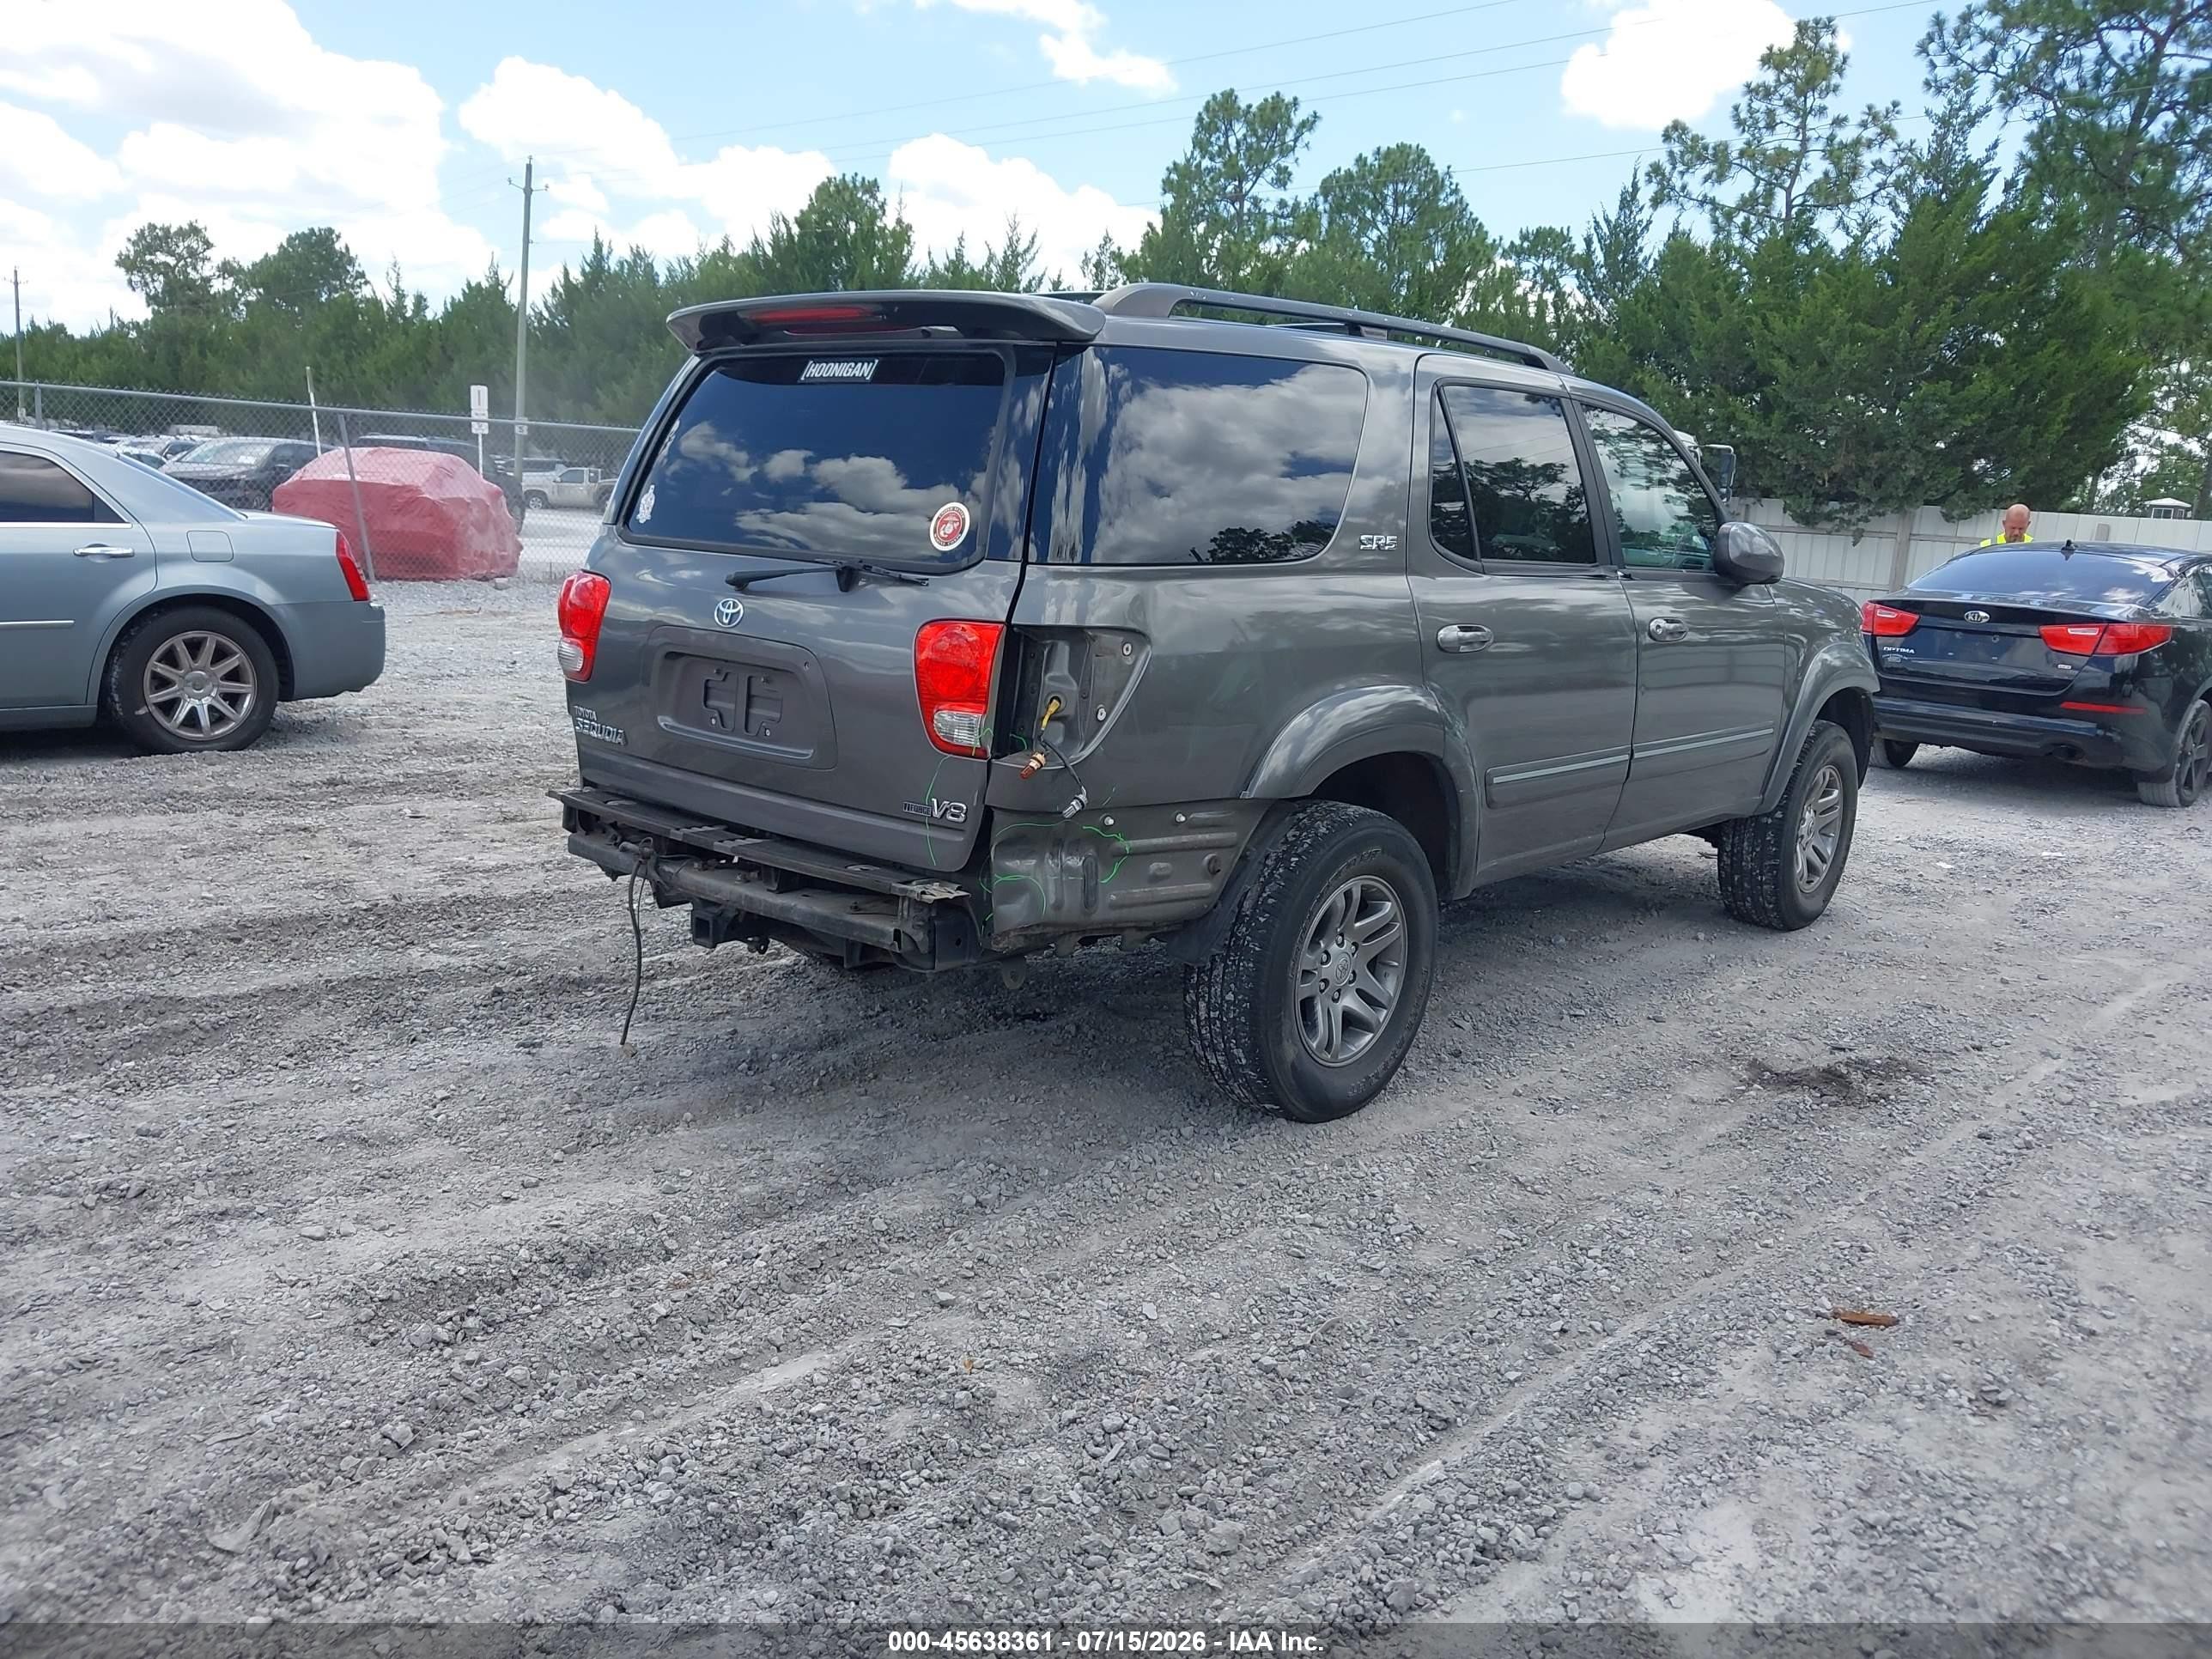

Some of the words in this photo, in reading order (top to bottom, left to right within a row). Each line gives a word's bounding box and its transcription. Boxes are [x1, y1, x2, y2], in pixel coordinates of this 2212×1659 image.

[1360, 534, 1398, 550] SR5
[574, 705, 598, 721] TOYOTA
[574, 717, 628, 746] SEQUOIA
[932, 798, 968, 823] V8
